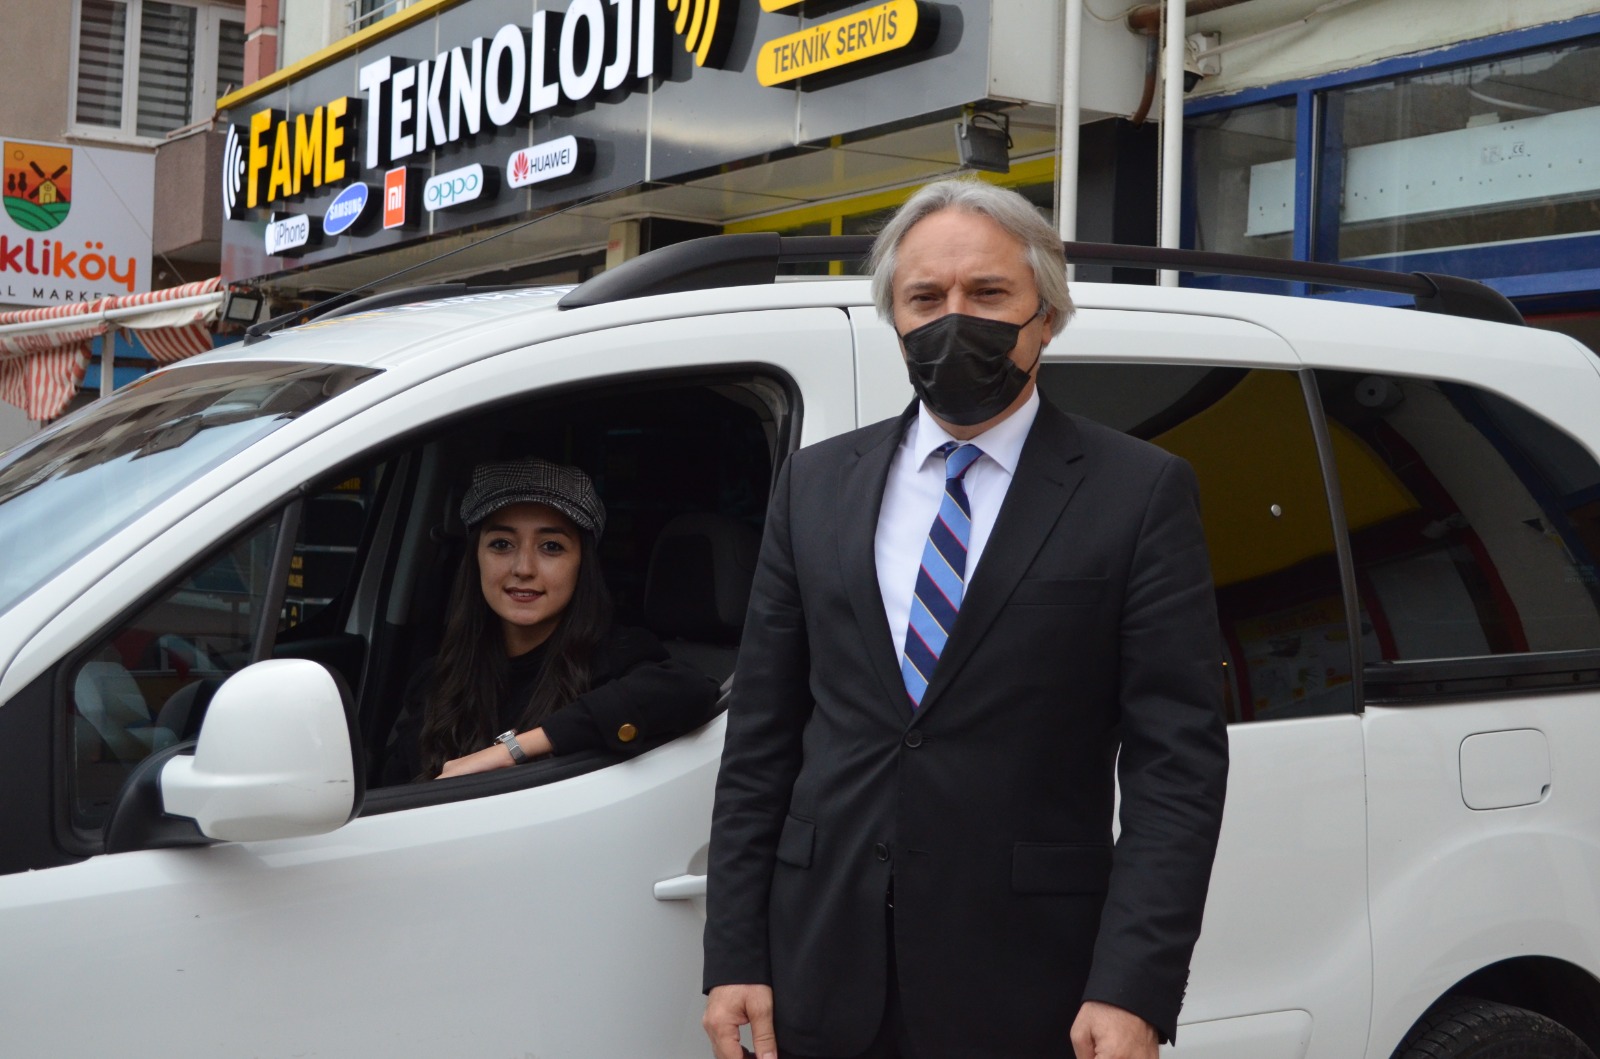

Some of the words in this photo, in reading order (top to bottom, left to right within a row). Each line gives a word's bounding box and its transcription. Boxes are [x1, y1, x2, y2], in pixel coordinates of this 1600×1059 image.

[773, 27, 832, 74] TEKNİK
[836, 6, 899, 56] SERVİS
[247, 96, 347, 208] FAME
[530, 148, 570, 173] HUAWEI
[428, 174, 478, 206] oppo
[330, 197, 362, 221] SAMSUNG
[275, 222, 306, 247] iPhone
[0, 285, 16, 297] L
